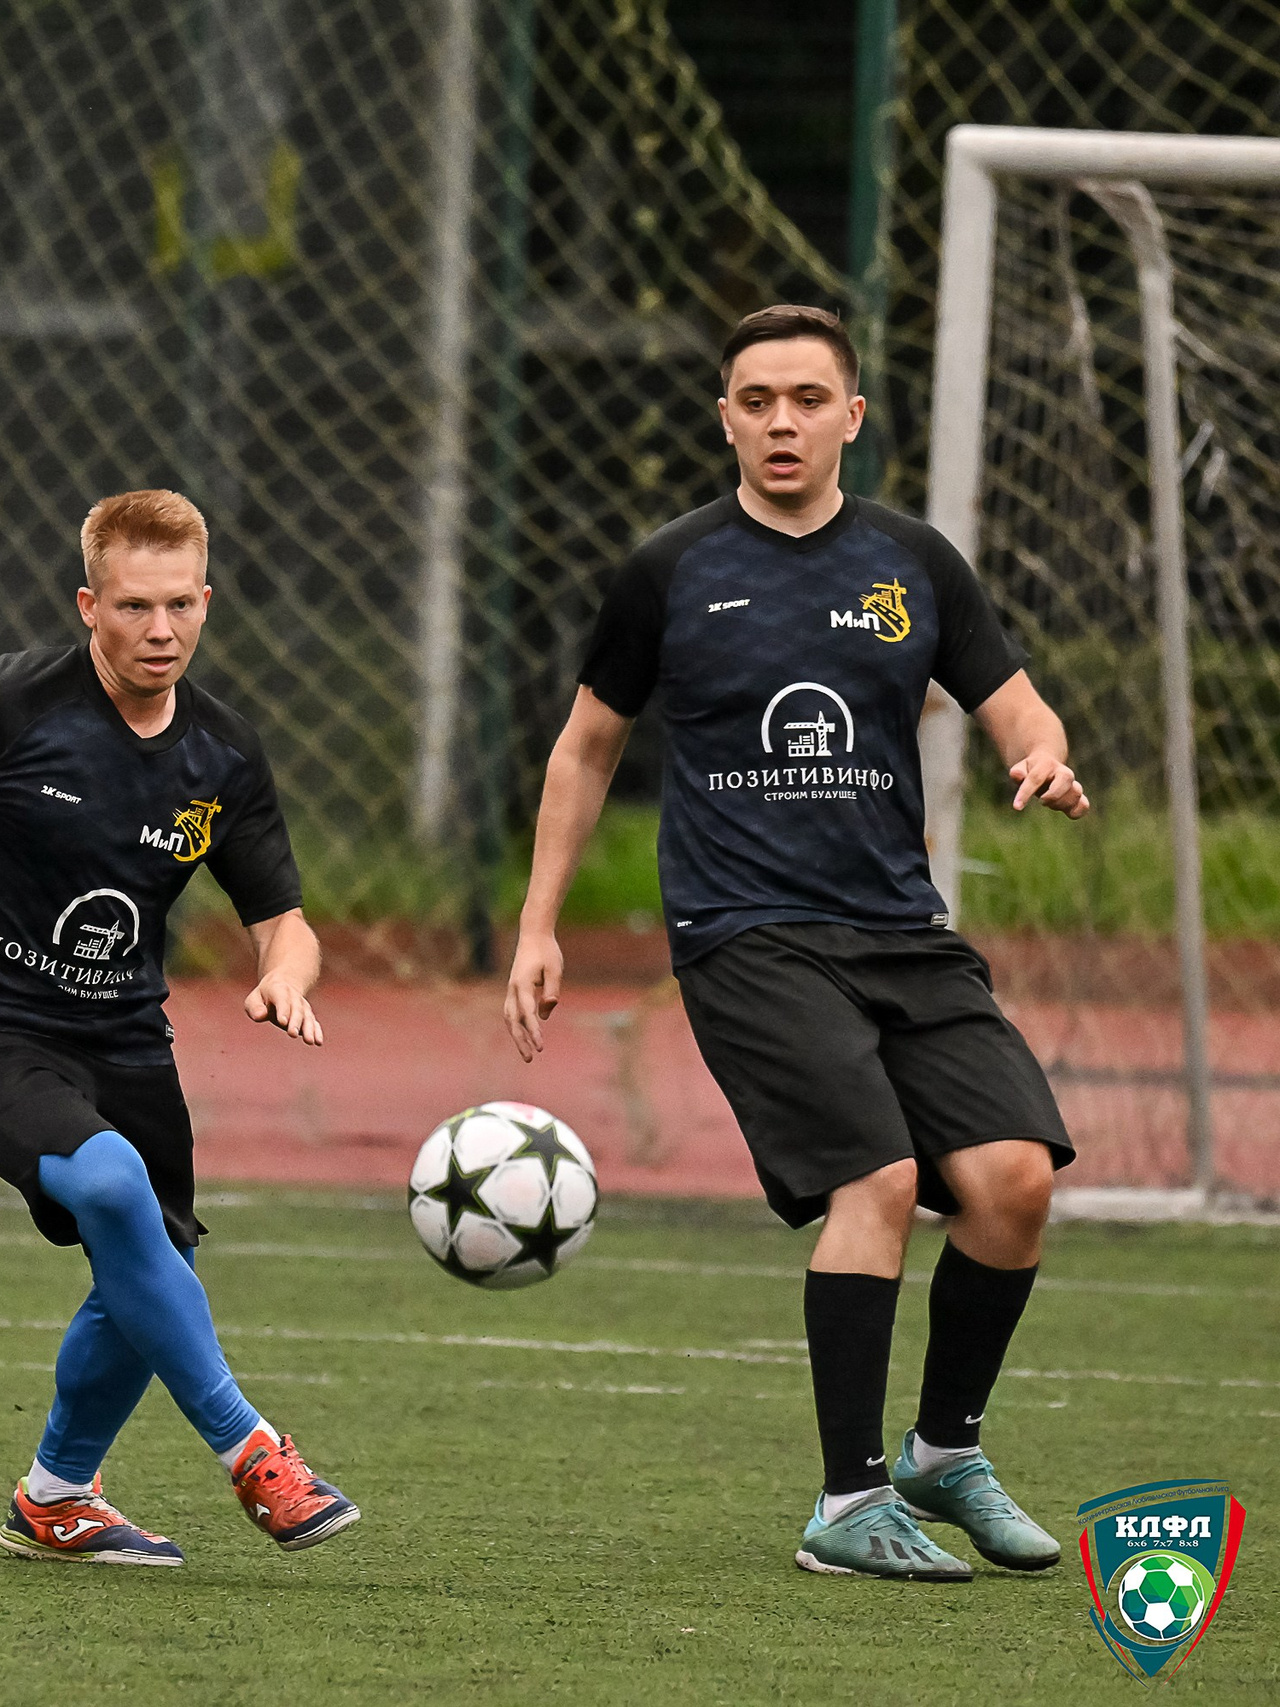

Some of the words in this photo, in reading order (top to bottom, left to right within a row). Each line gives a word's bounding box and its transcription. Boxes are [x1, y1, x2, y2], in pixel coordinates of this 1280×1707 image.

[722, 599, 751, 610] SPORT
[830, 610, 880, 631] МиП
[708, 767, 894, 791] ПОЗИТИВИНФО
[55, 791, 82, 804] SPORT
[764, 790, 808, 801] СТРОИМ
[811, 790, 857, 800] БУДУЩЕЕ
[140, 825, 185, 852] МиП
[80, 988, 120, 1000] БУДУЩЕЕ
